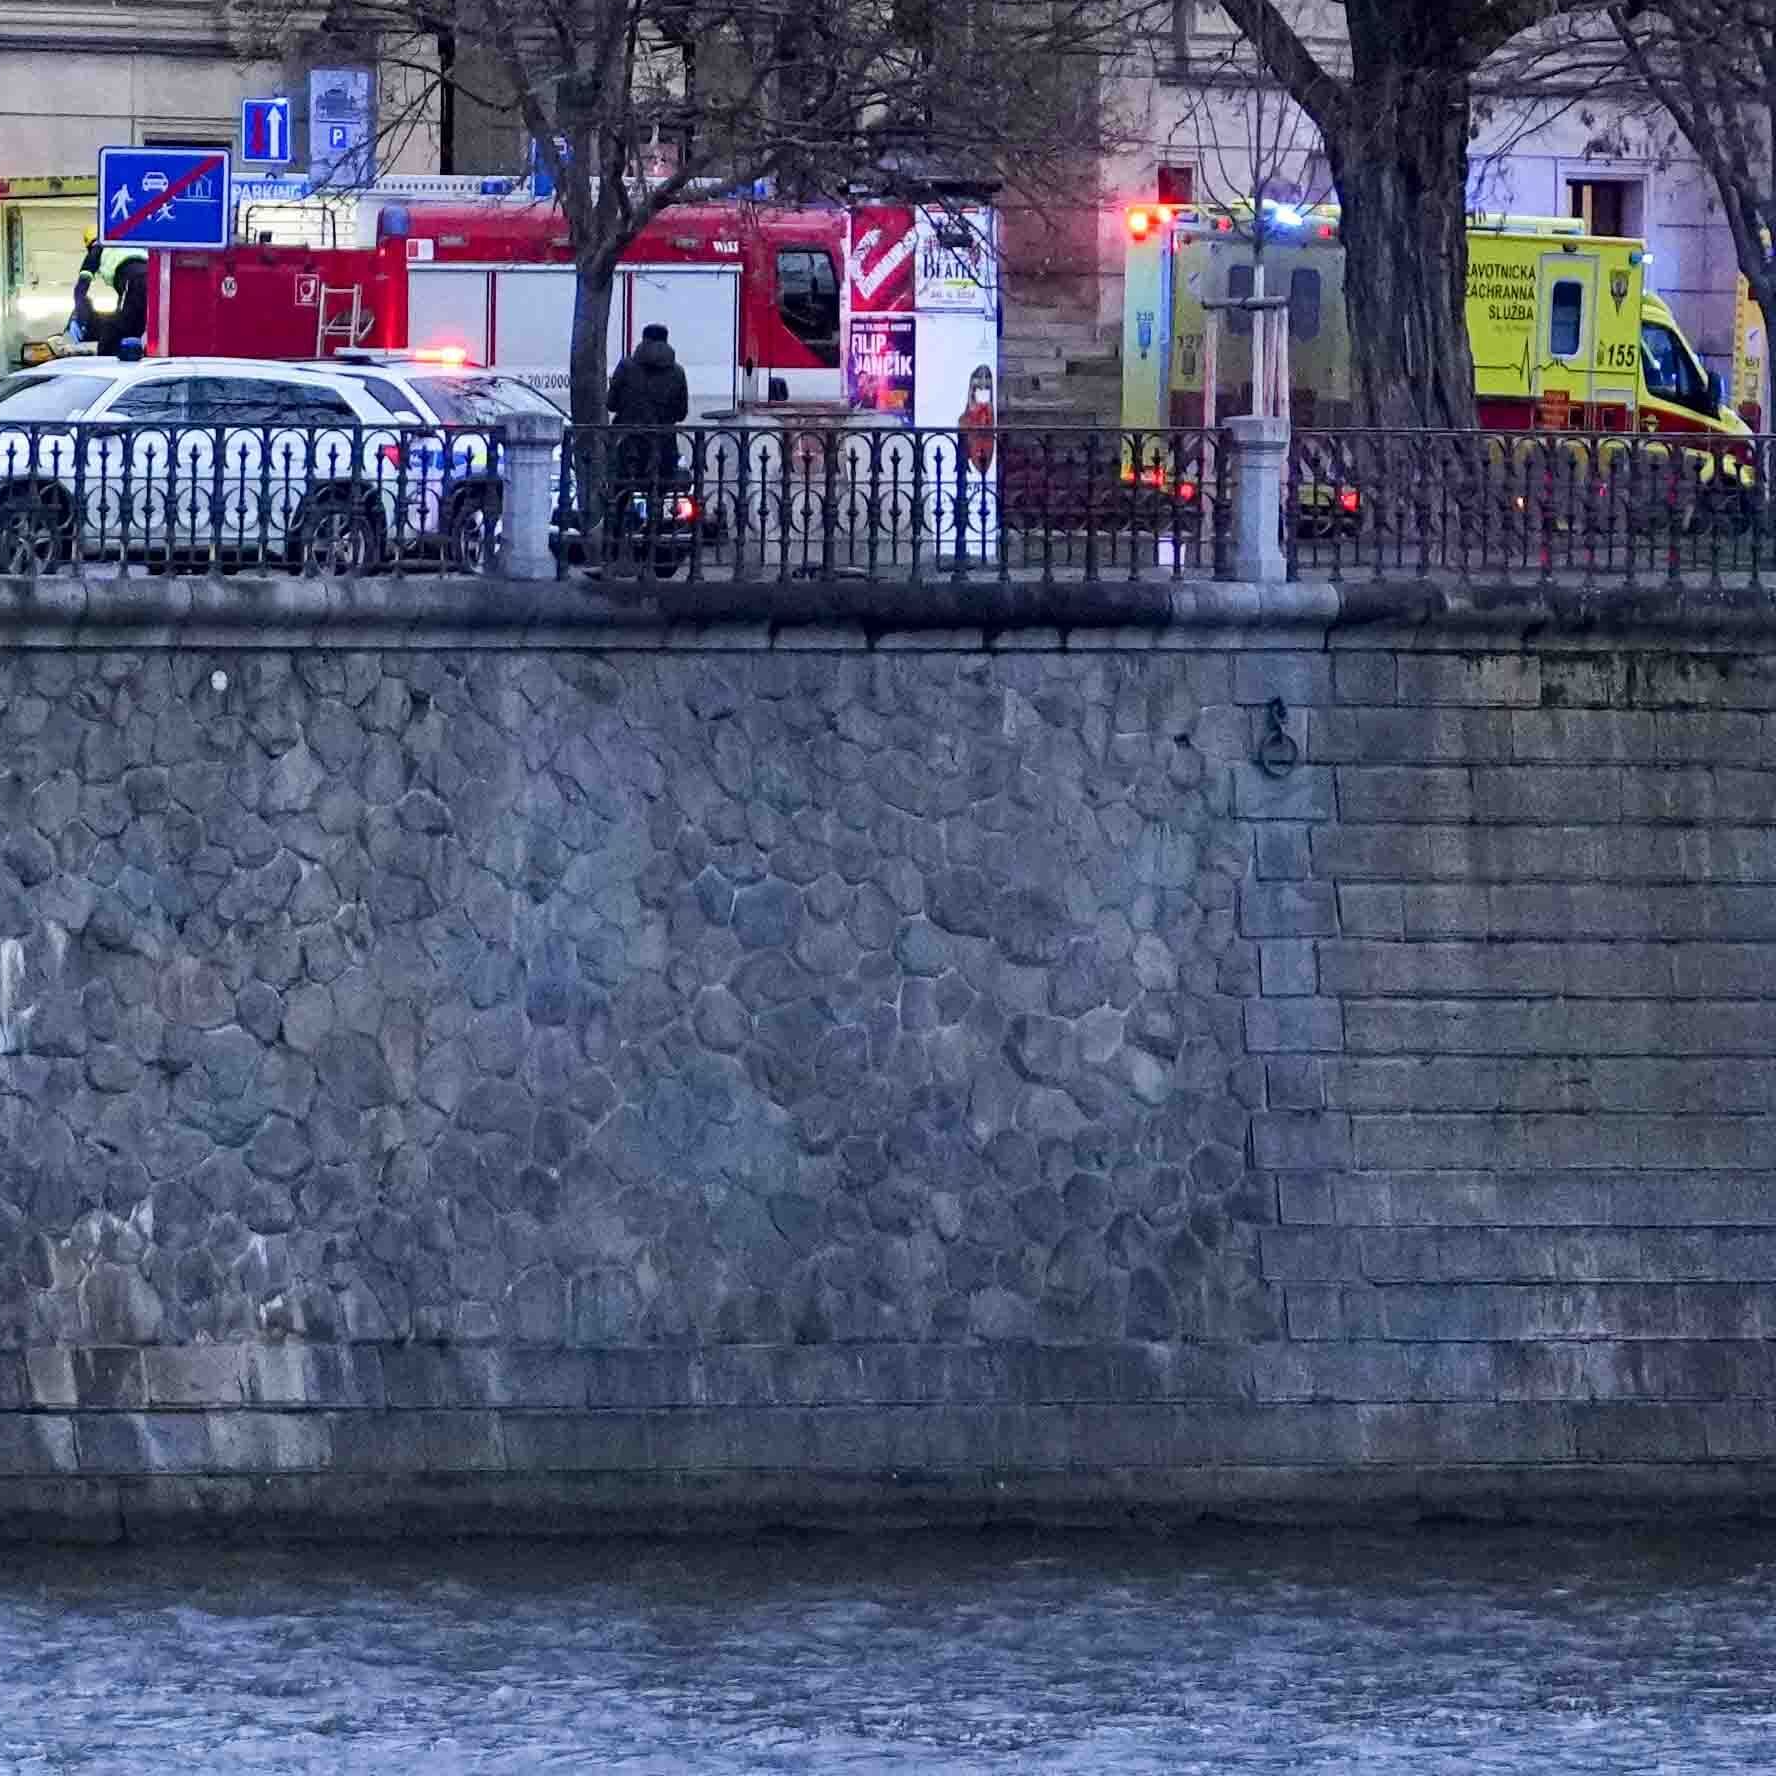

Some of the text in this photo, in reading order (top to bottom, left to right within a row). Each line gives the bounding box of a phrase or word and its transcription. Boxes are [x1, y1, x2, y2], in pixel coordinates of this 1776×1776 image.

[332, 129, 344, 145] P
[233, 183, 302, 202] PARKING
[1607, 343, 1636, 368] 155
